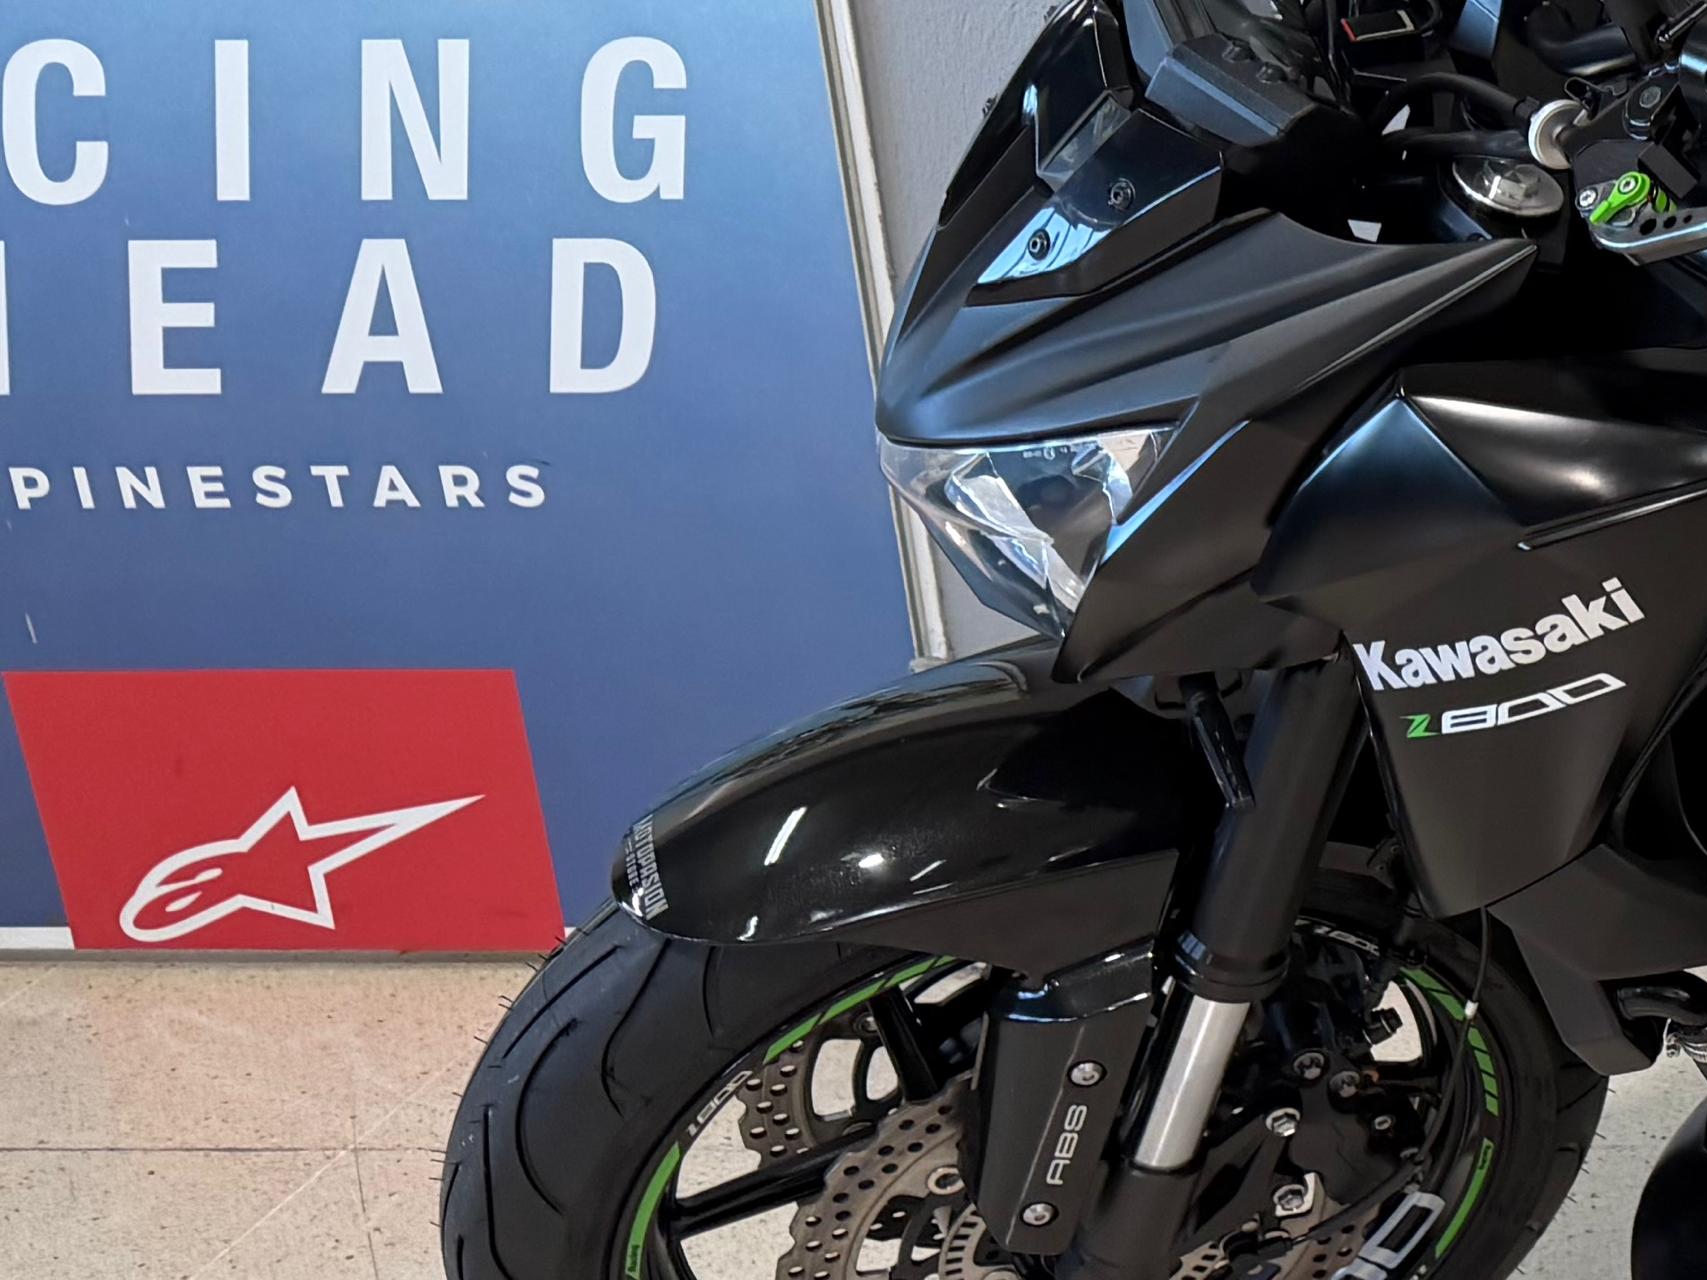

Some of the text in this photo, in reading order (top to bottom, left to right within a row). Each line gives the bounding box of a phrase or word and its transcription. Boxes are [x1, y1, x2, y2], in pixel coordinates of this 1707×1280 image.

[2, 37, 688, 205] CING
[0, 238, 657, 395] EAD
[11, 465, 546, 509] PINESTARS
[1352, 576, 1645, 691] Kawasaki
[1401, 672, 1627, 739] Z800
[1046, 1104, 1088, 1186] ABS
